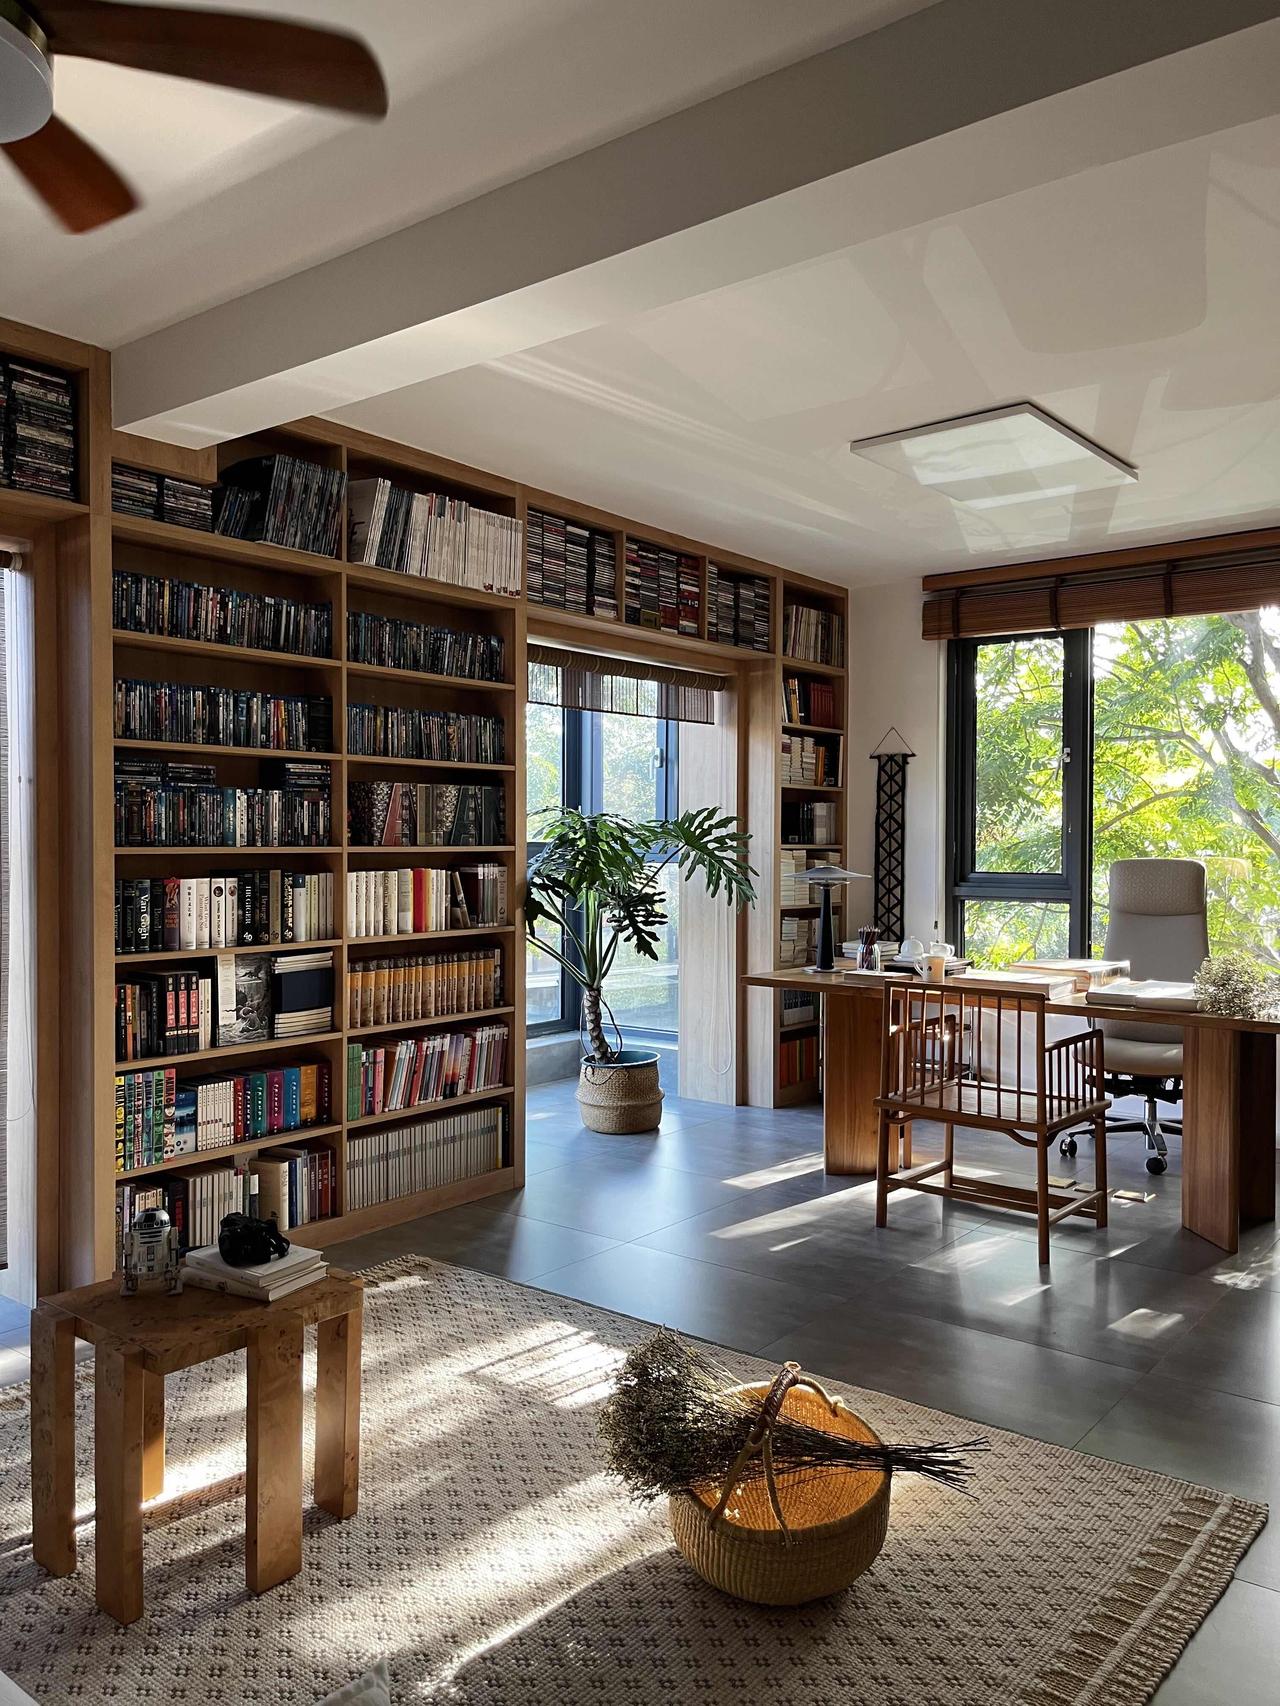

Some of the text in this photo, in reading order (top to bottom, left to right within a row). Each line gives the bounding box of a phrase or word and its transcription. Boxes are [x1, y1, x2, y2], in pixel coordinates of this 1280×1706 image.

[245, 886, 252, 897] HR
[138, 894, 149, 940] Van Gogh
[154, 908, 162, 932] Bosch
[116, 1085, 124, 1104] AKIRA
[155, 1078, 163, 1098] AKIRA
[166, 1077, 174, 1096] AKIRA
